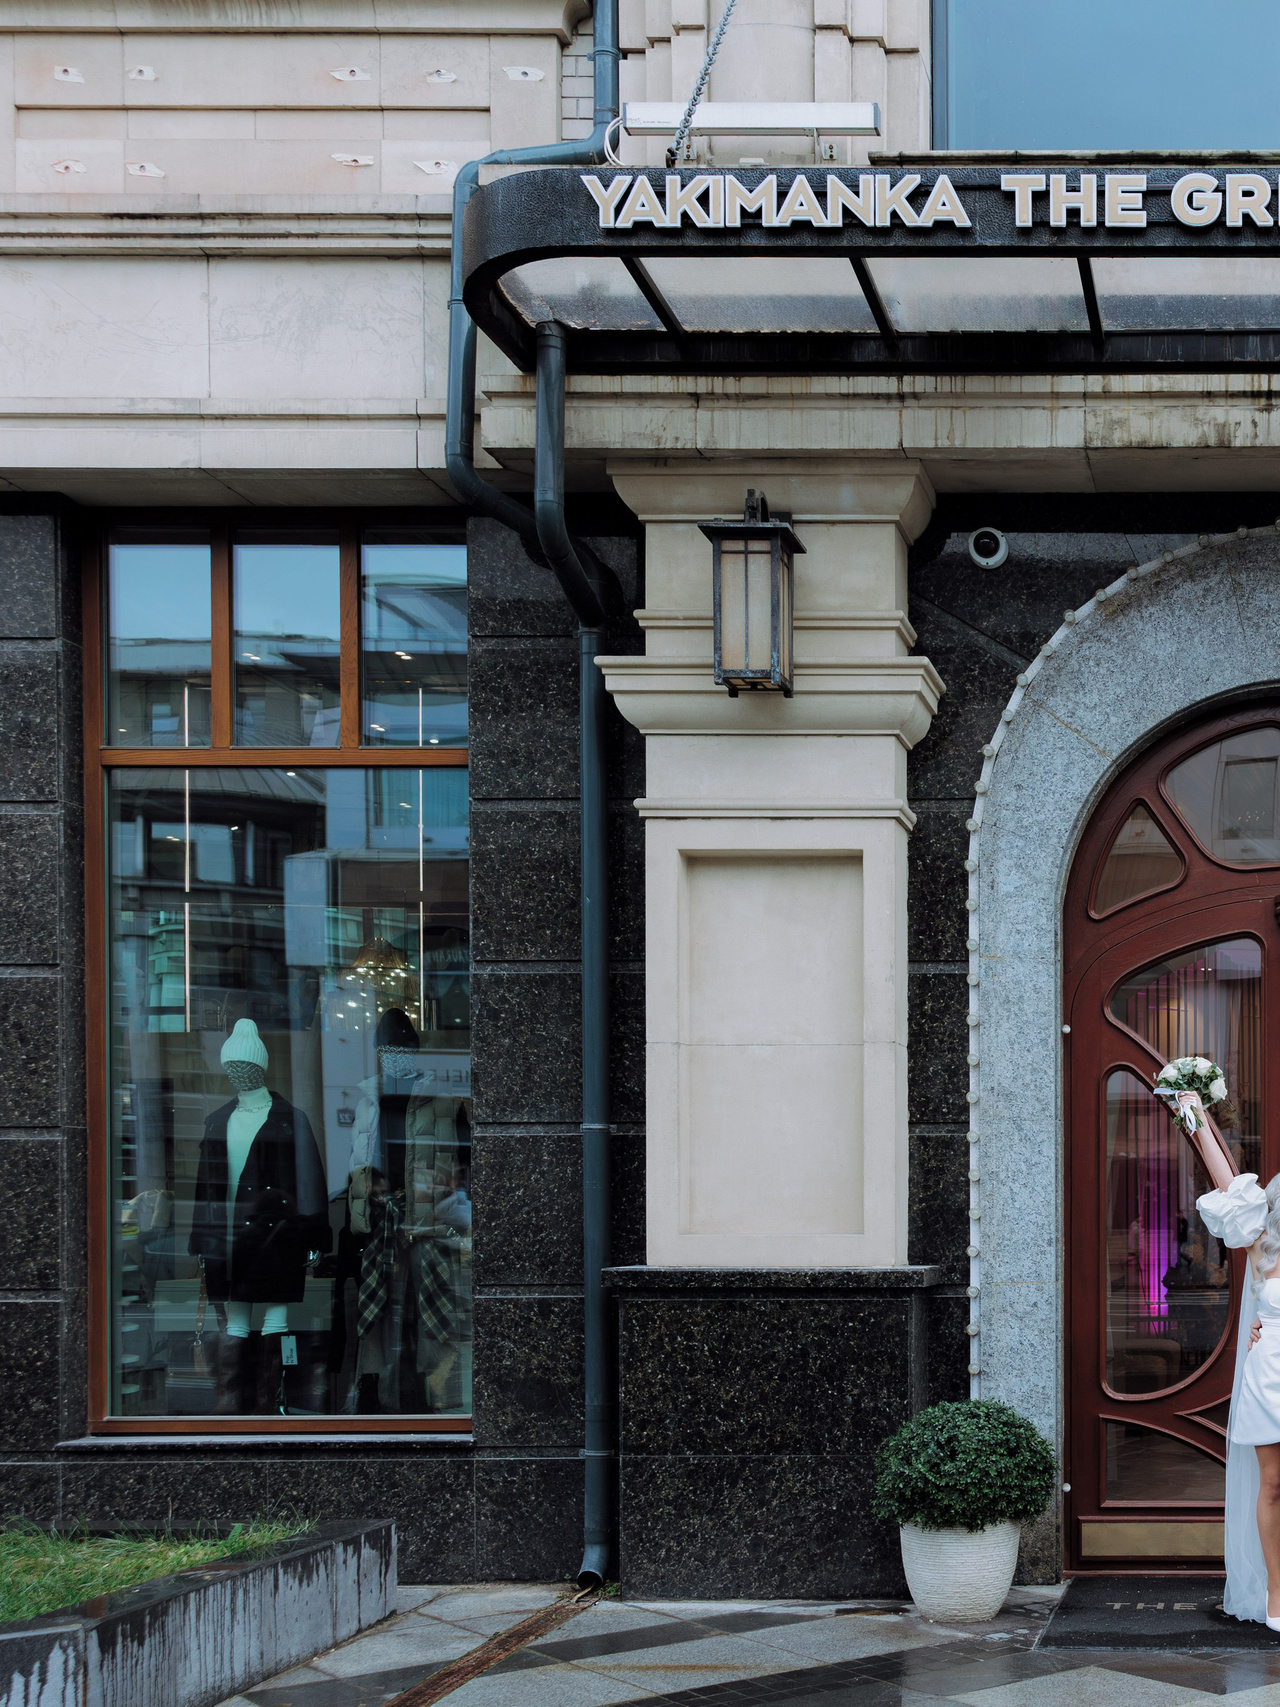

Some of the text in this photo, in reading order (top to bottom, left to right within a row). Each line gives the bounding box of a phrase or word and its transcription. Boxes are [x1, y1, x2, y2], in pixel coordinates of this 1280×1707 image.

[581, 174, 972, 228] YAKIMANKA
[1001, 174, 1148, 228] THE
[1105, 1602, 1198, 1610] THE
